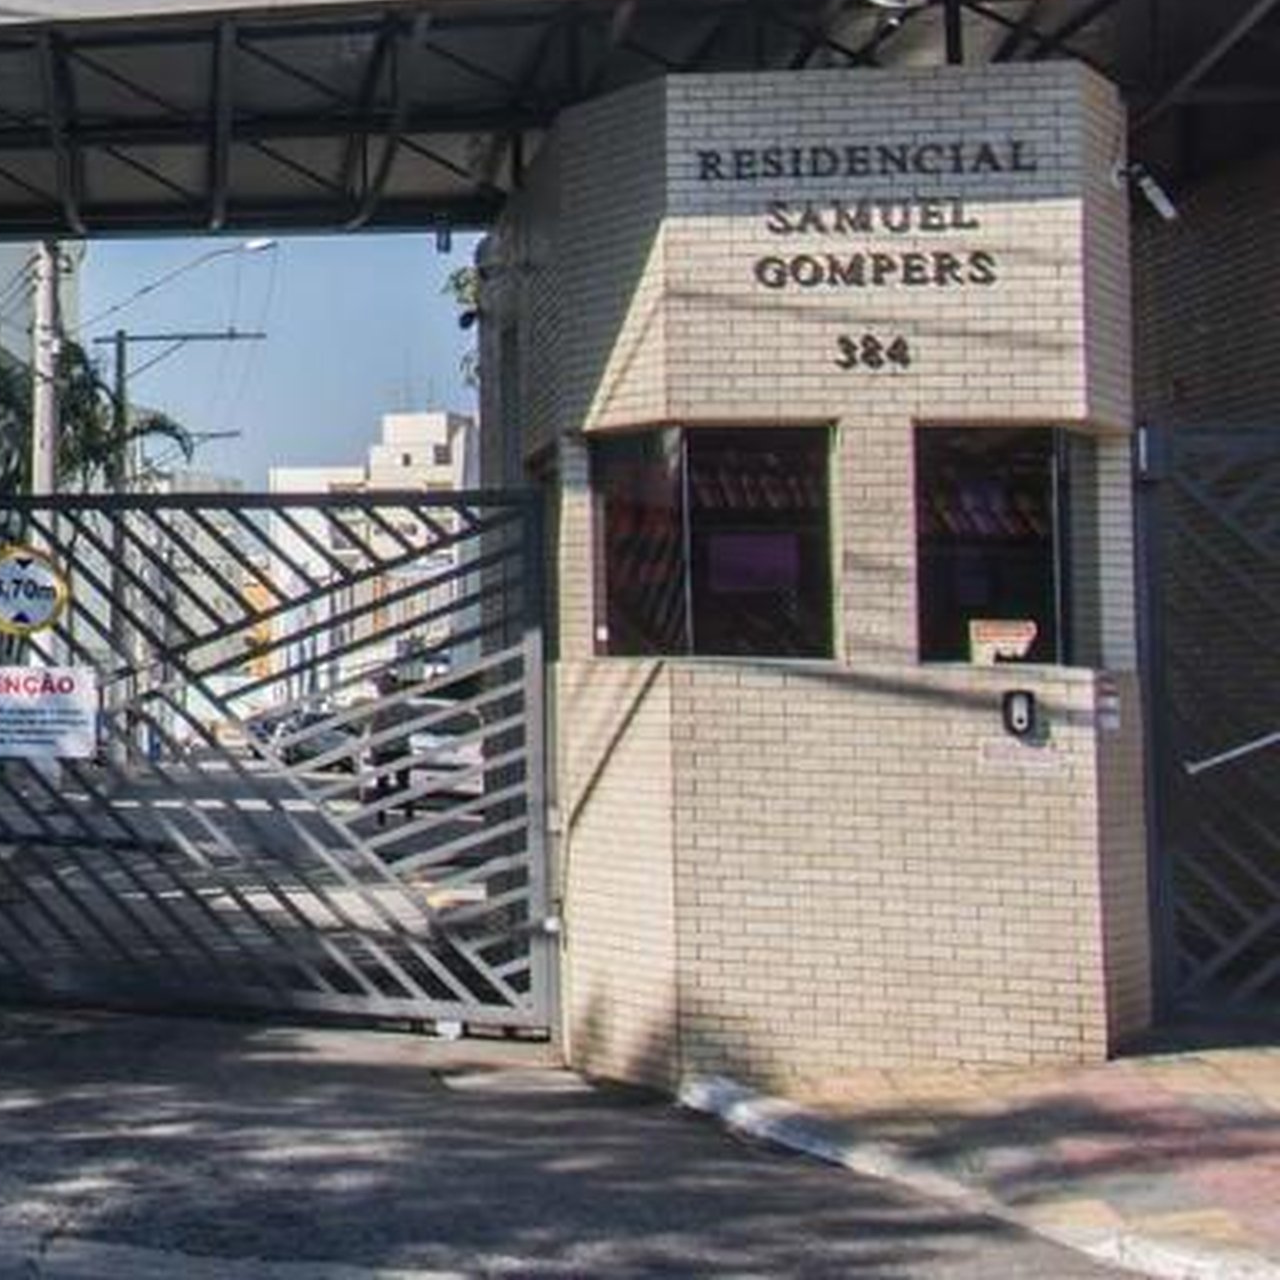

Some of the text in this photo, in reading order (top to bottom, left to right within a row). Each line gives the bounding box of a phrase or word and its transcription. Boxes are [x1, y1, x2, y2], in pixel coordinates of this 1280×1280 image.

[698, 140, 1037, 181] RESIDENCIAL
[766, 198, 979, 235] SAMUEL
[755, 251, 998, 289] GOMPERS
[834, 335, 912, 370] 384
